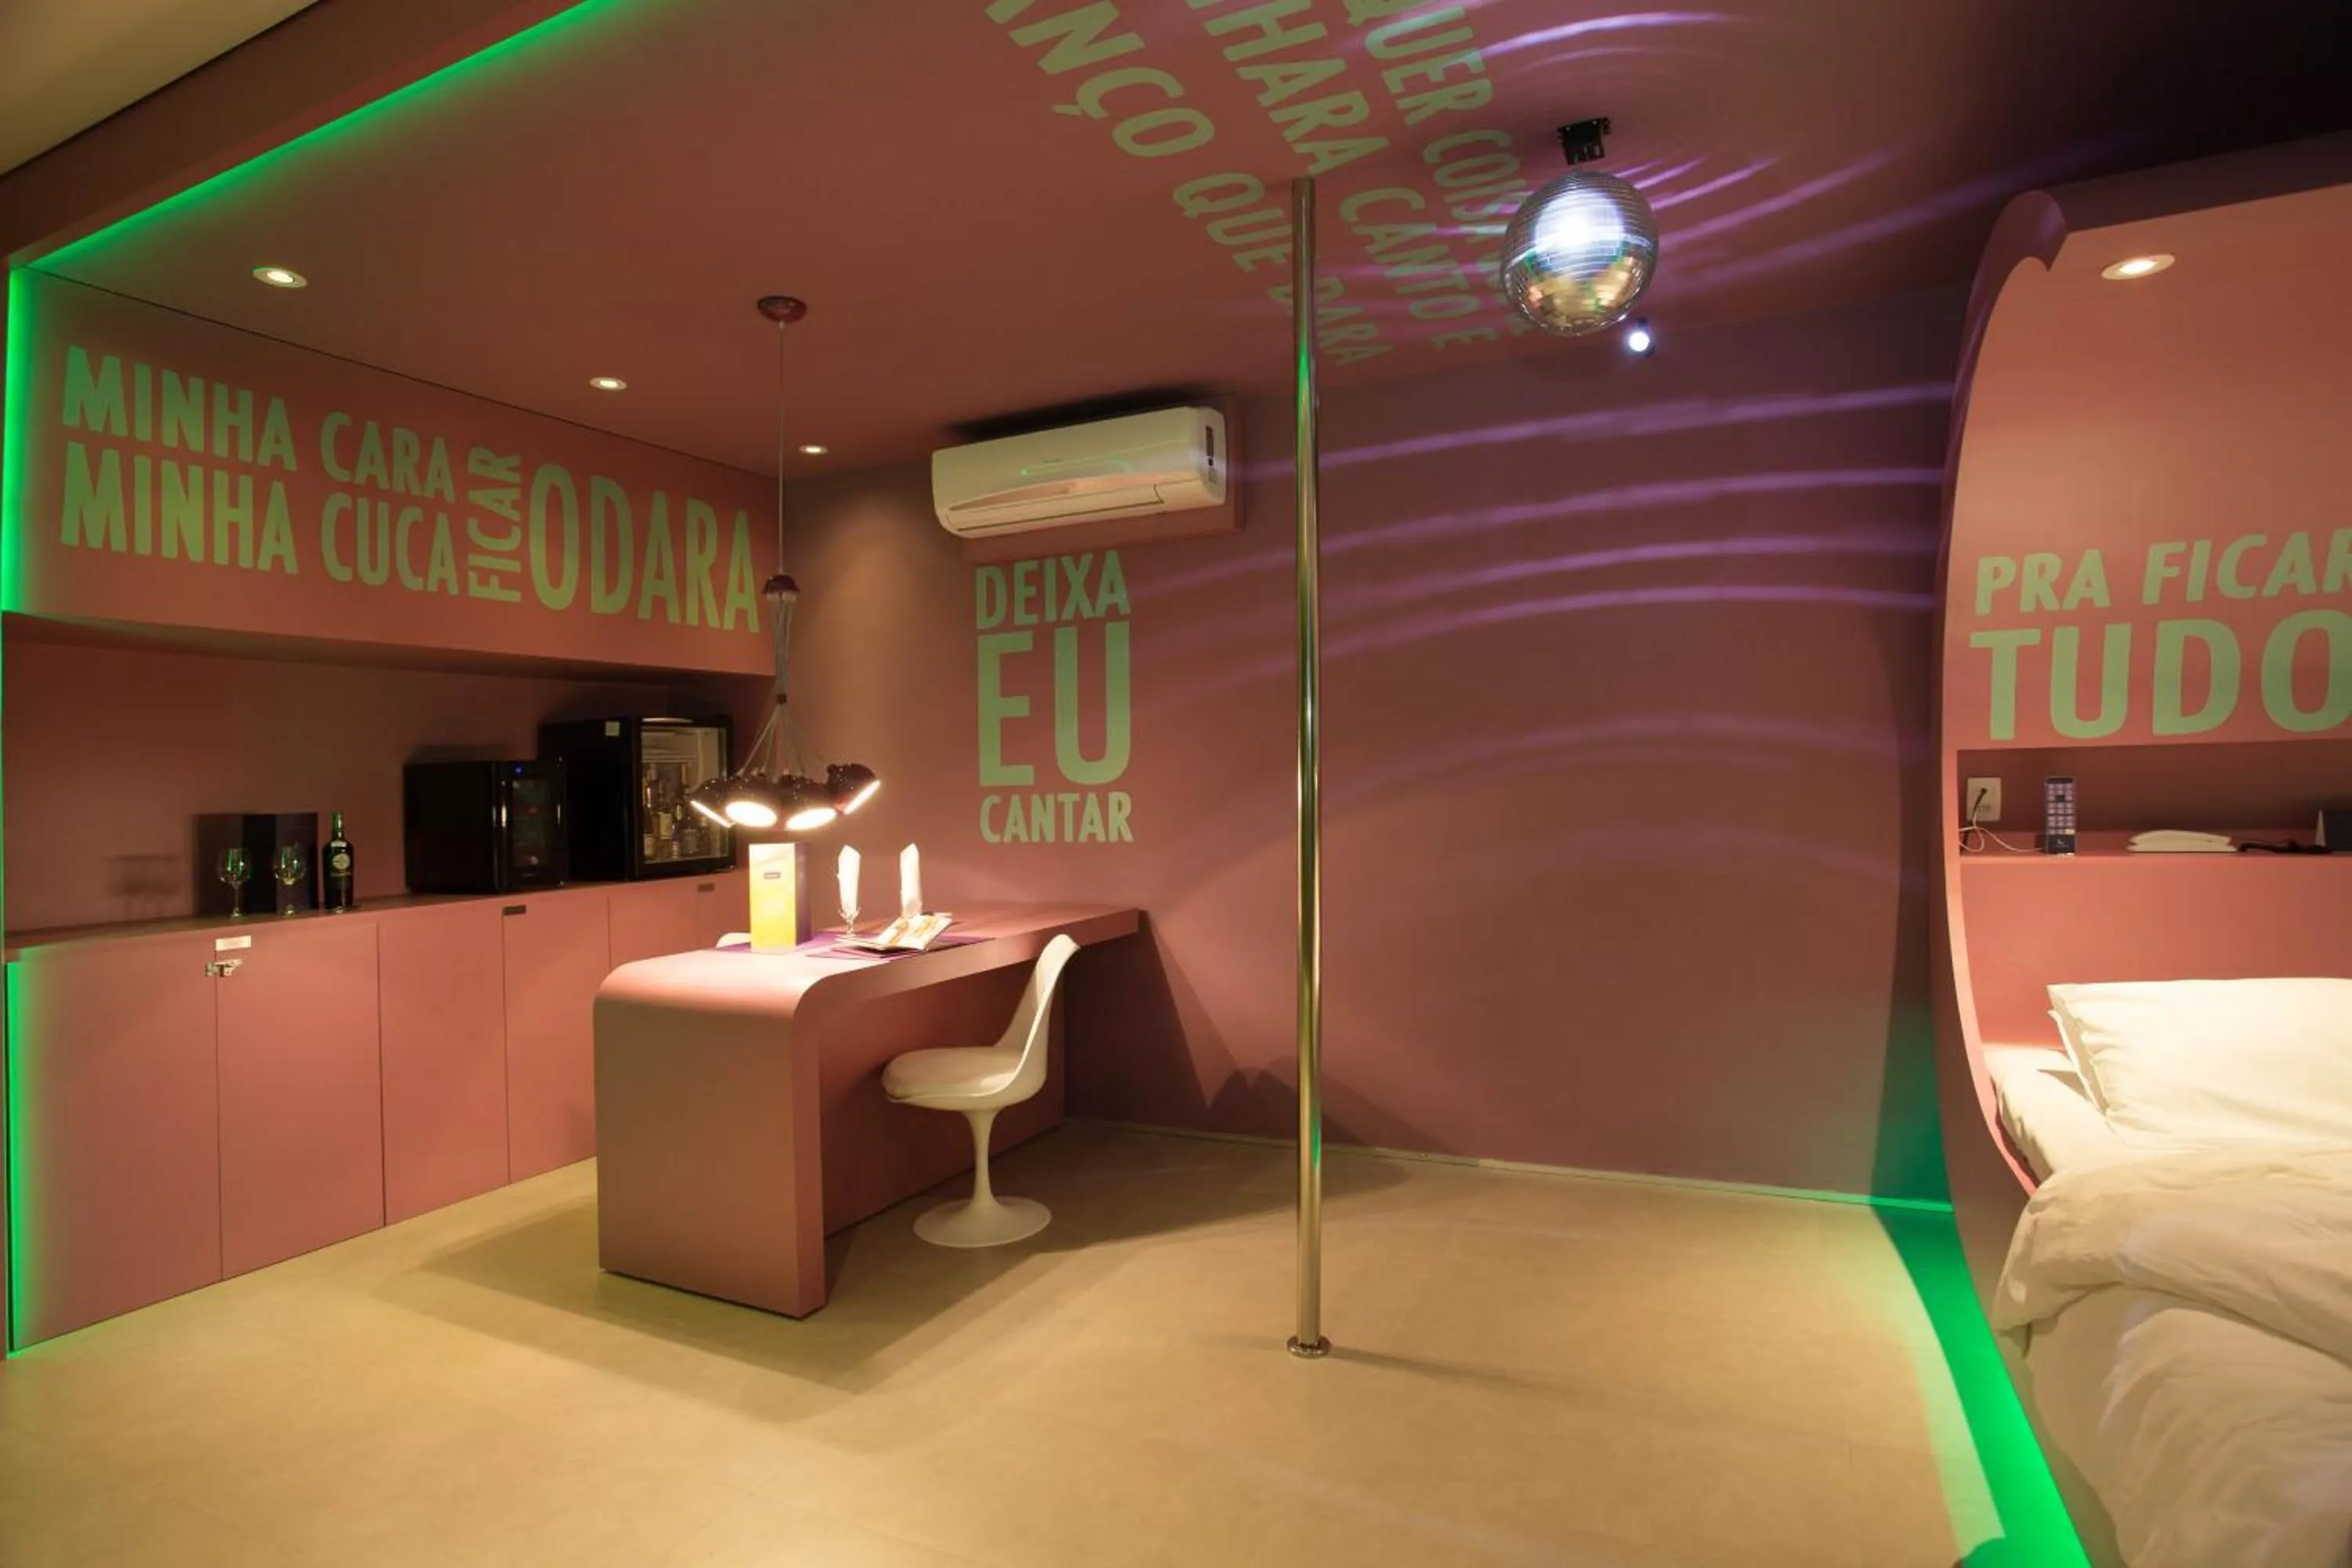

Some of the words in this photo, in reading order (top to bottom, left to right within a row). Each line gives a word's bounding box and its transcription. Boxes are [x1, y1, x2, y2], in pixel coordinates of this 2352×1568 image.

[985, 0, 1214, 156] NÇO
[1174, 173, 1294, 273] QUE
[1186, 0, 1390, 176] HARA
[1340, 187, 1479, 320] CANTO
[1431, 326, 1500, 349] E
[63, 346, 298, 471] MINHA
[321, 412, 456, 503] CARA
[60, 441, 299, 575] MINHA
[321, 492, 459, 596] CUCA
[467, 447, 522, 603] FICAR
[528, 463, 760, 633] ODARA
[976, 550, 1131, 629] DEIXA
[1975, 549, 2111, 615] PRA
[2142, 528, 2352, 605] FICAR
[978, 620, 1131, 787] EU
[1969, 608, 2352, 740] TUDO
[980, 792, 1134, 843] CANTAR
